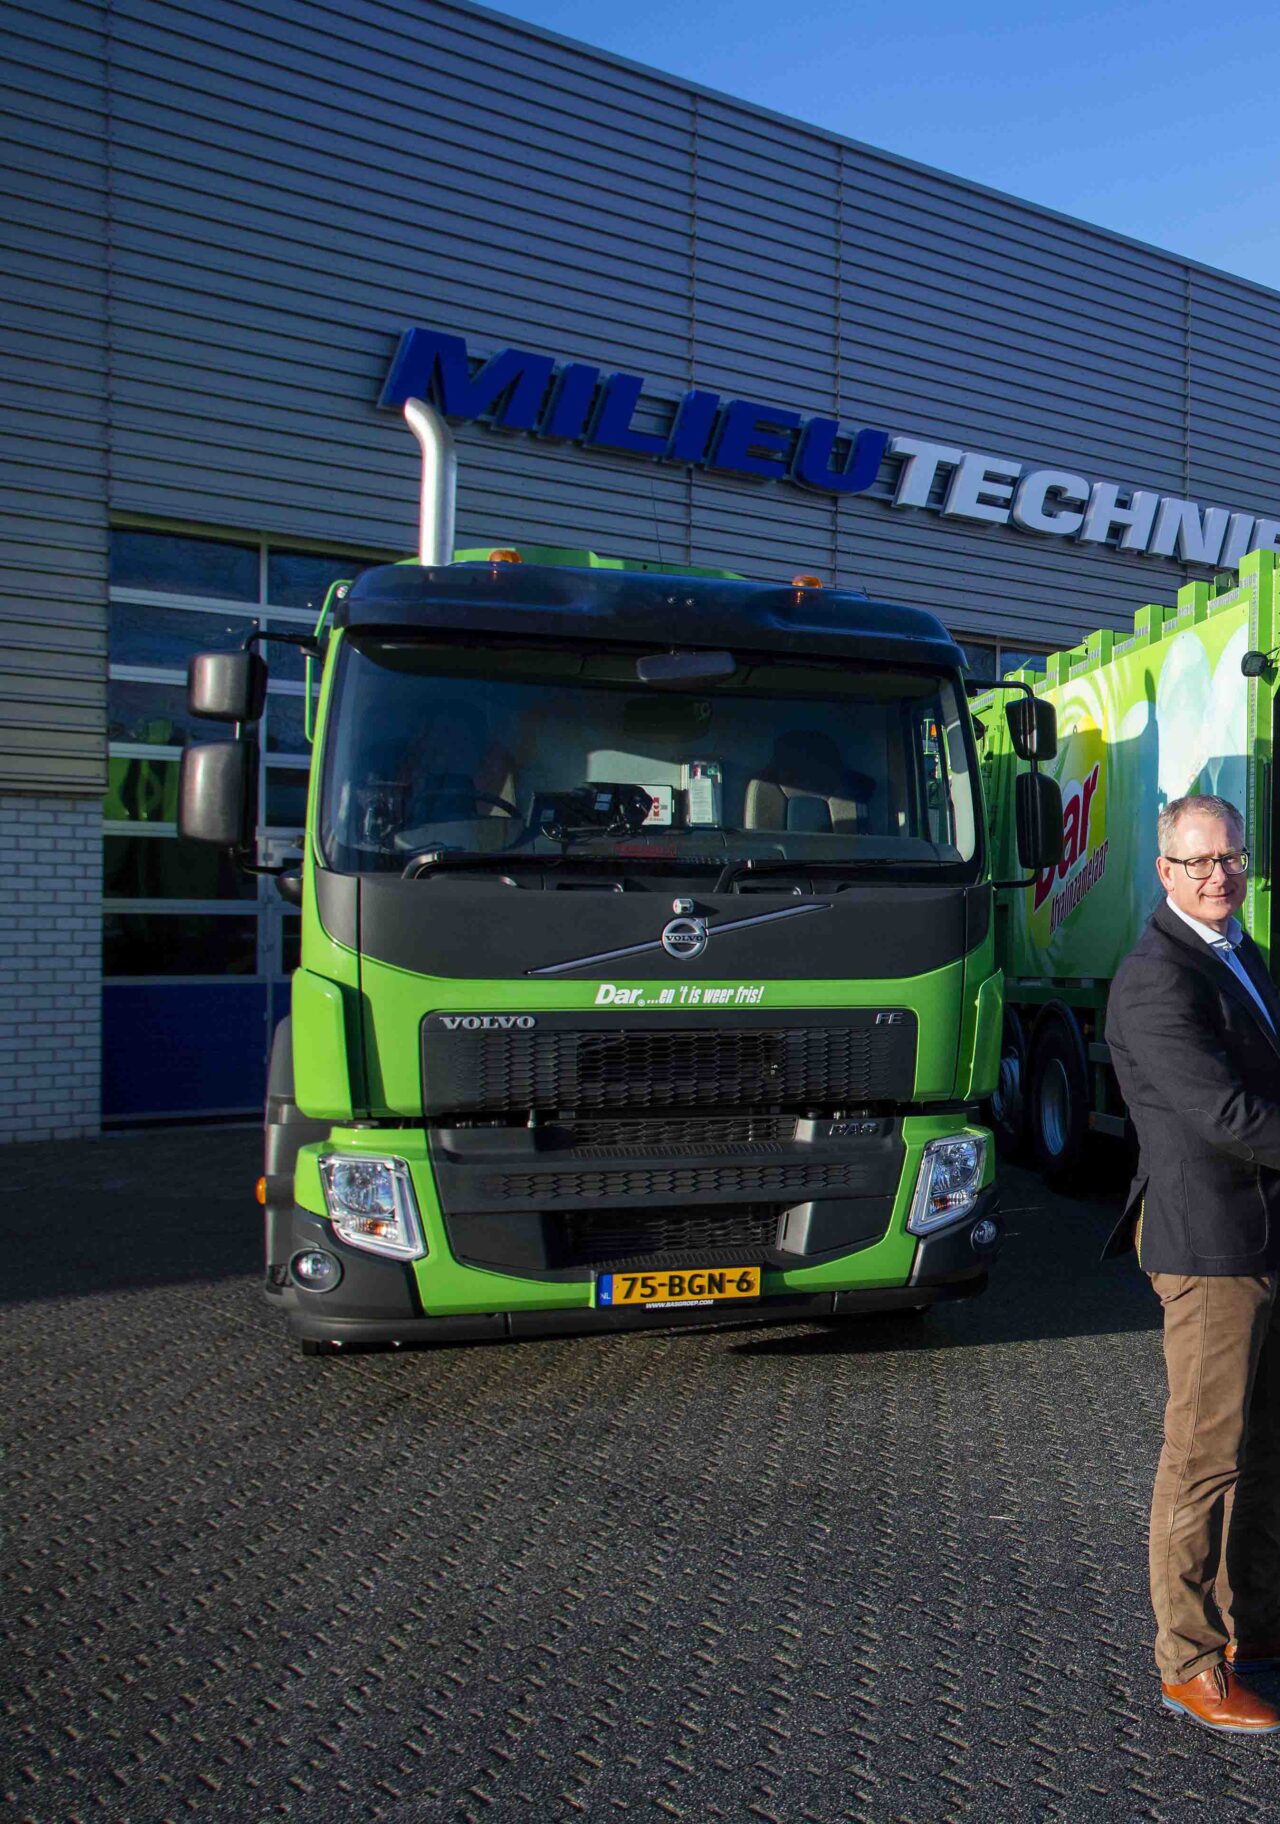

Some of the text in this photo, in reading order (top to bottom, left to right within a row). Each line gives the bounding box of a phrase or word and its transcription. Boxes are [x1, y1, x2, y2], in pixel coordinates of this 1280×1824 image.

[688, 986, 702, 1004] is
[703, 988, 735, 1004] weer
[734, 985, 765, 1004] fris!
[440, 1016, 536, 1030] VOLVO
[875, 1012, 903, 1025] FE
[621, 1271, 755, 1299] 75-BGN-6
[600, 1291, 612, 1300] NL
